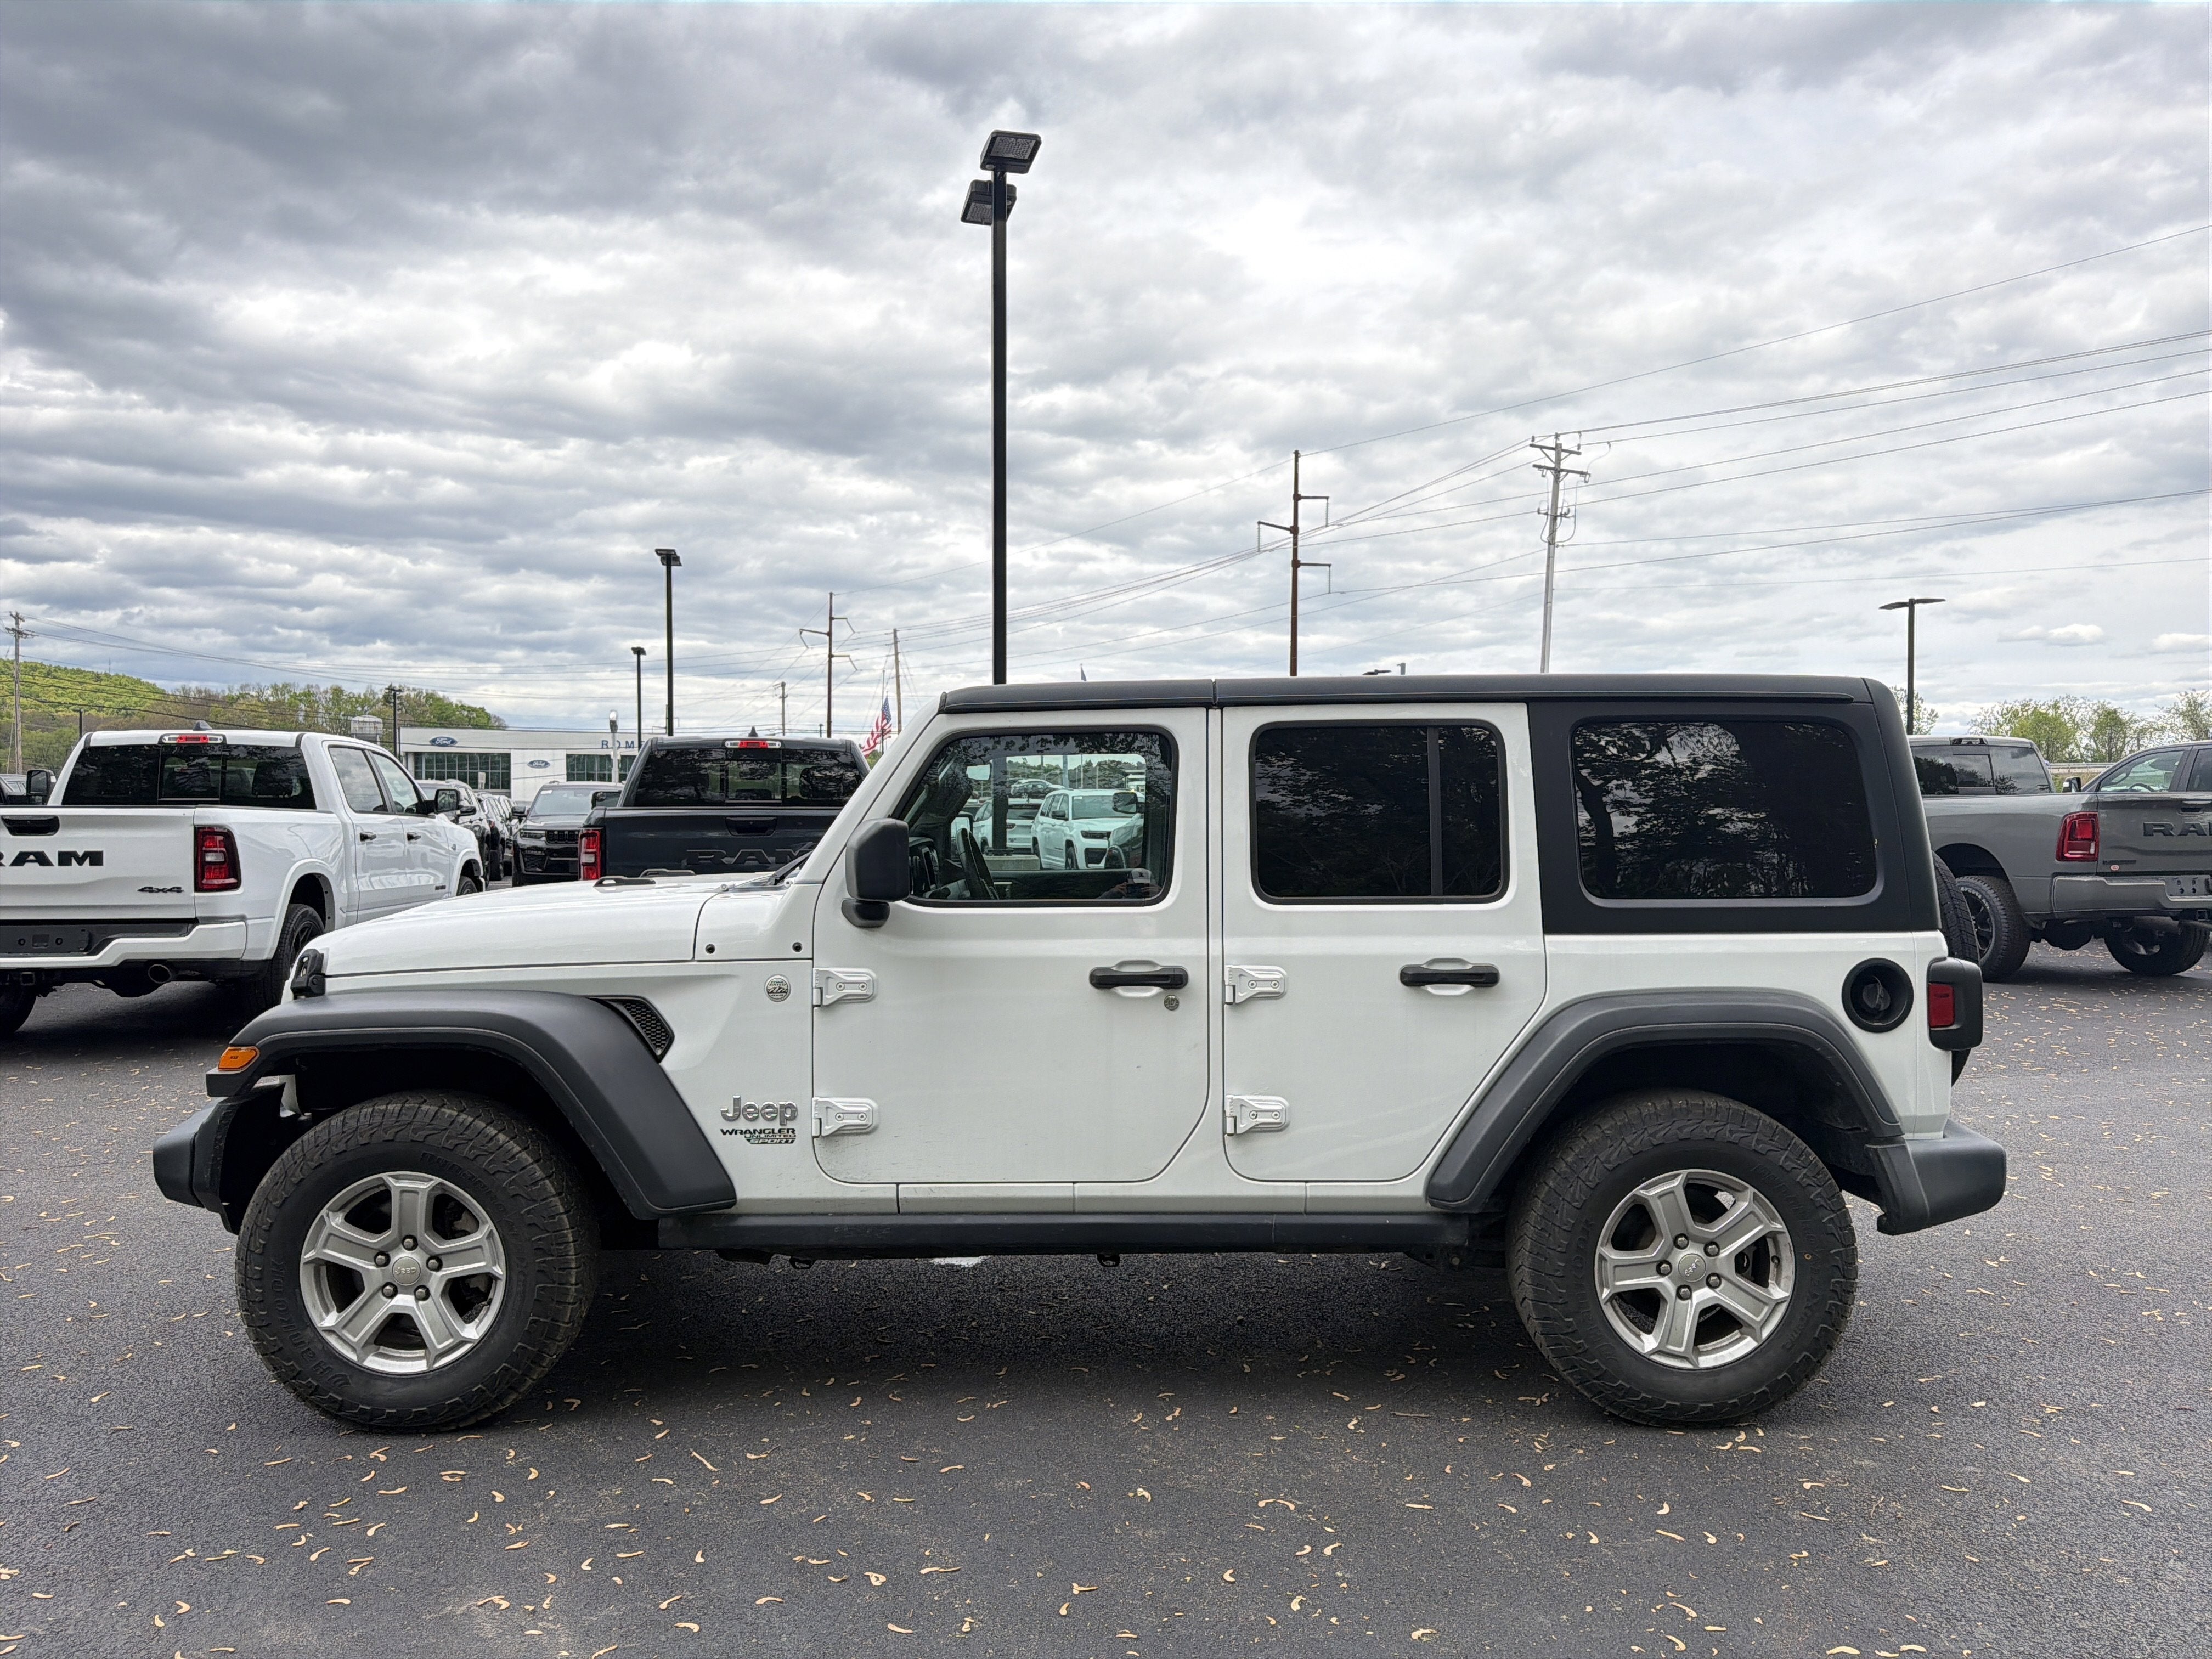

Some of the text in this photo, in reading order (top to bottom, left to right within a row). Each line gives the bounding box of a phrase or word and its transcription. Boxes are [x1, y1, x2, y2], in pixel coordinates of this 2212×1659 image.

[433, 737, 453, 745] Ford
[601, 740, 646, 750] ROM
[2143, 822, 2212, 837] RA
[0, 850, 104, 866] AM
[720, 1096, 798, 1126] Jeep
